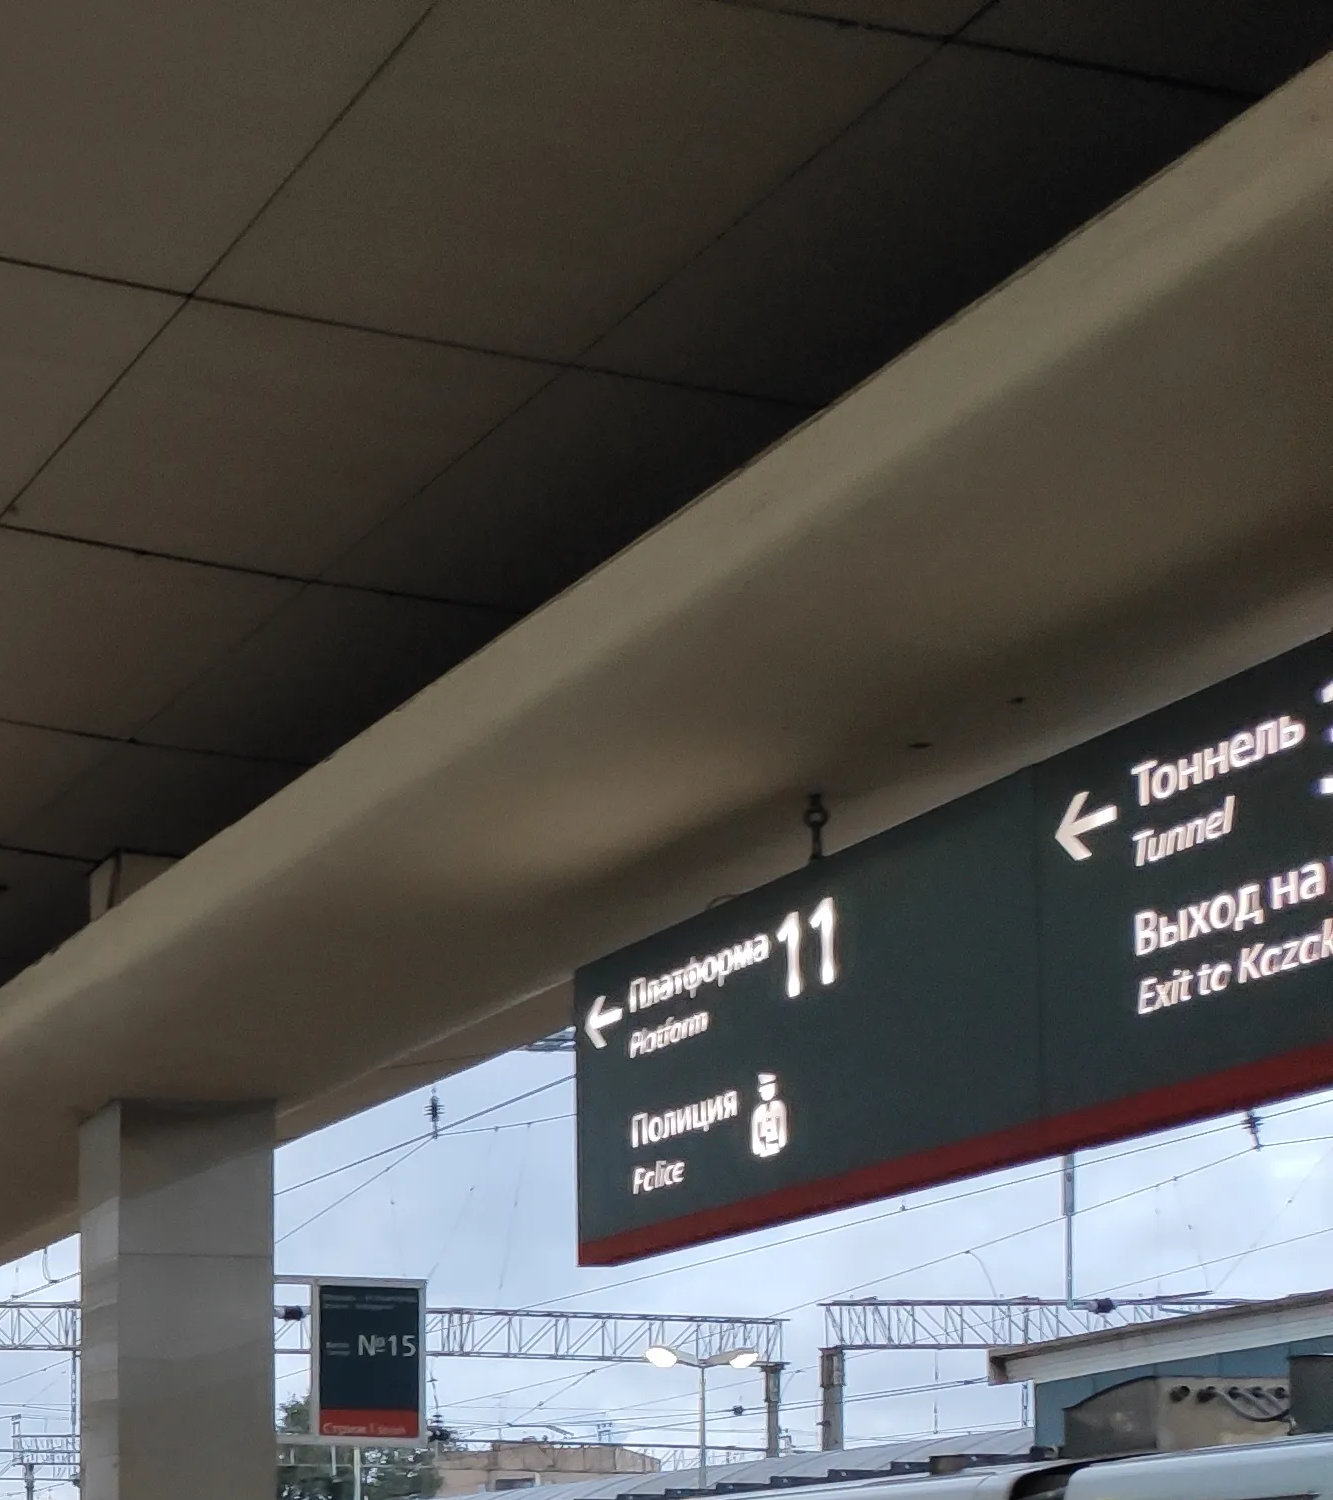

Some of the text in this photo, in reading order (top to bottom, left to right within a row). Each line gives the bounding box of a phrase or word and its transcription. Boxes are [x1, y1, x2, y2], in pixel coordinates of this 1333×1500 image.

[1131, 716, 1306, 806] Тоннель
[1132, 795, 1236, 867] Tunnel
[1135, 862, 1326, 956] Выход на
[629, 896, 837, 1013] Платформа 11
[1137, 967, 1194, 1015] Exit
[1196, 961, 1233, 996] to
[629, 1011, 709, 1059] Platform
[631, 1090, 738, 1148] Полиция
[633, 1160, 686, 1195] Police
[357, 1334, 417, 1357] №15
